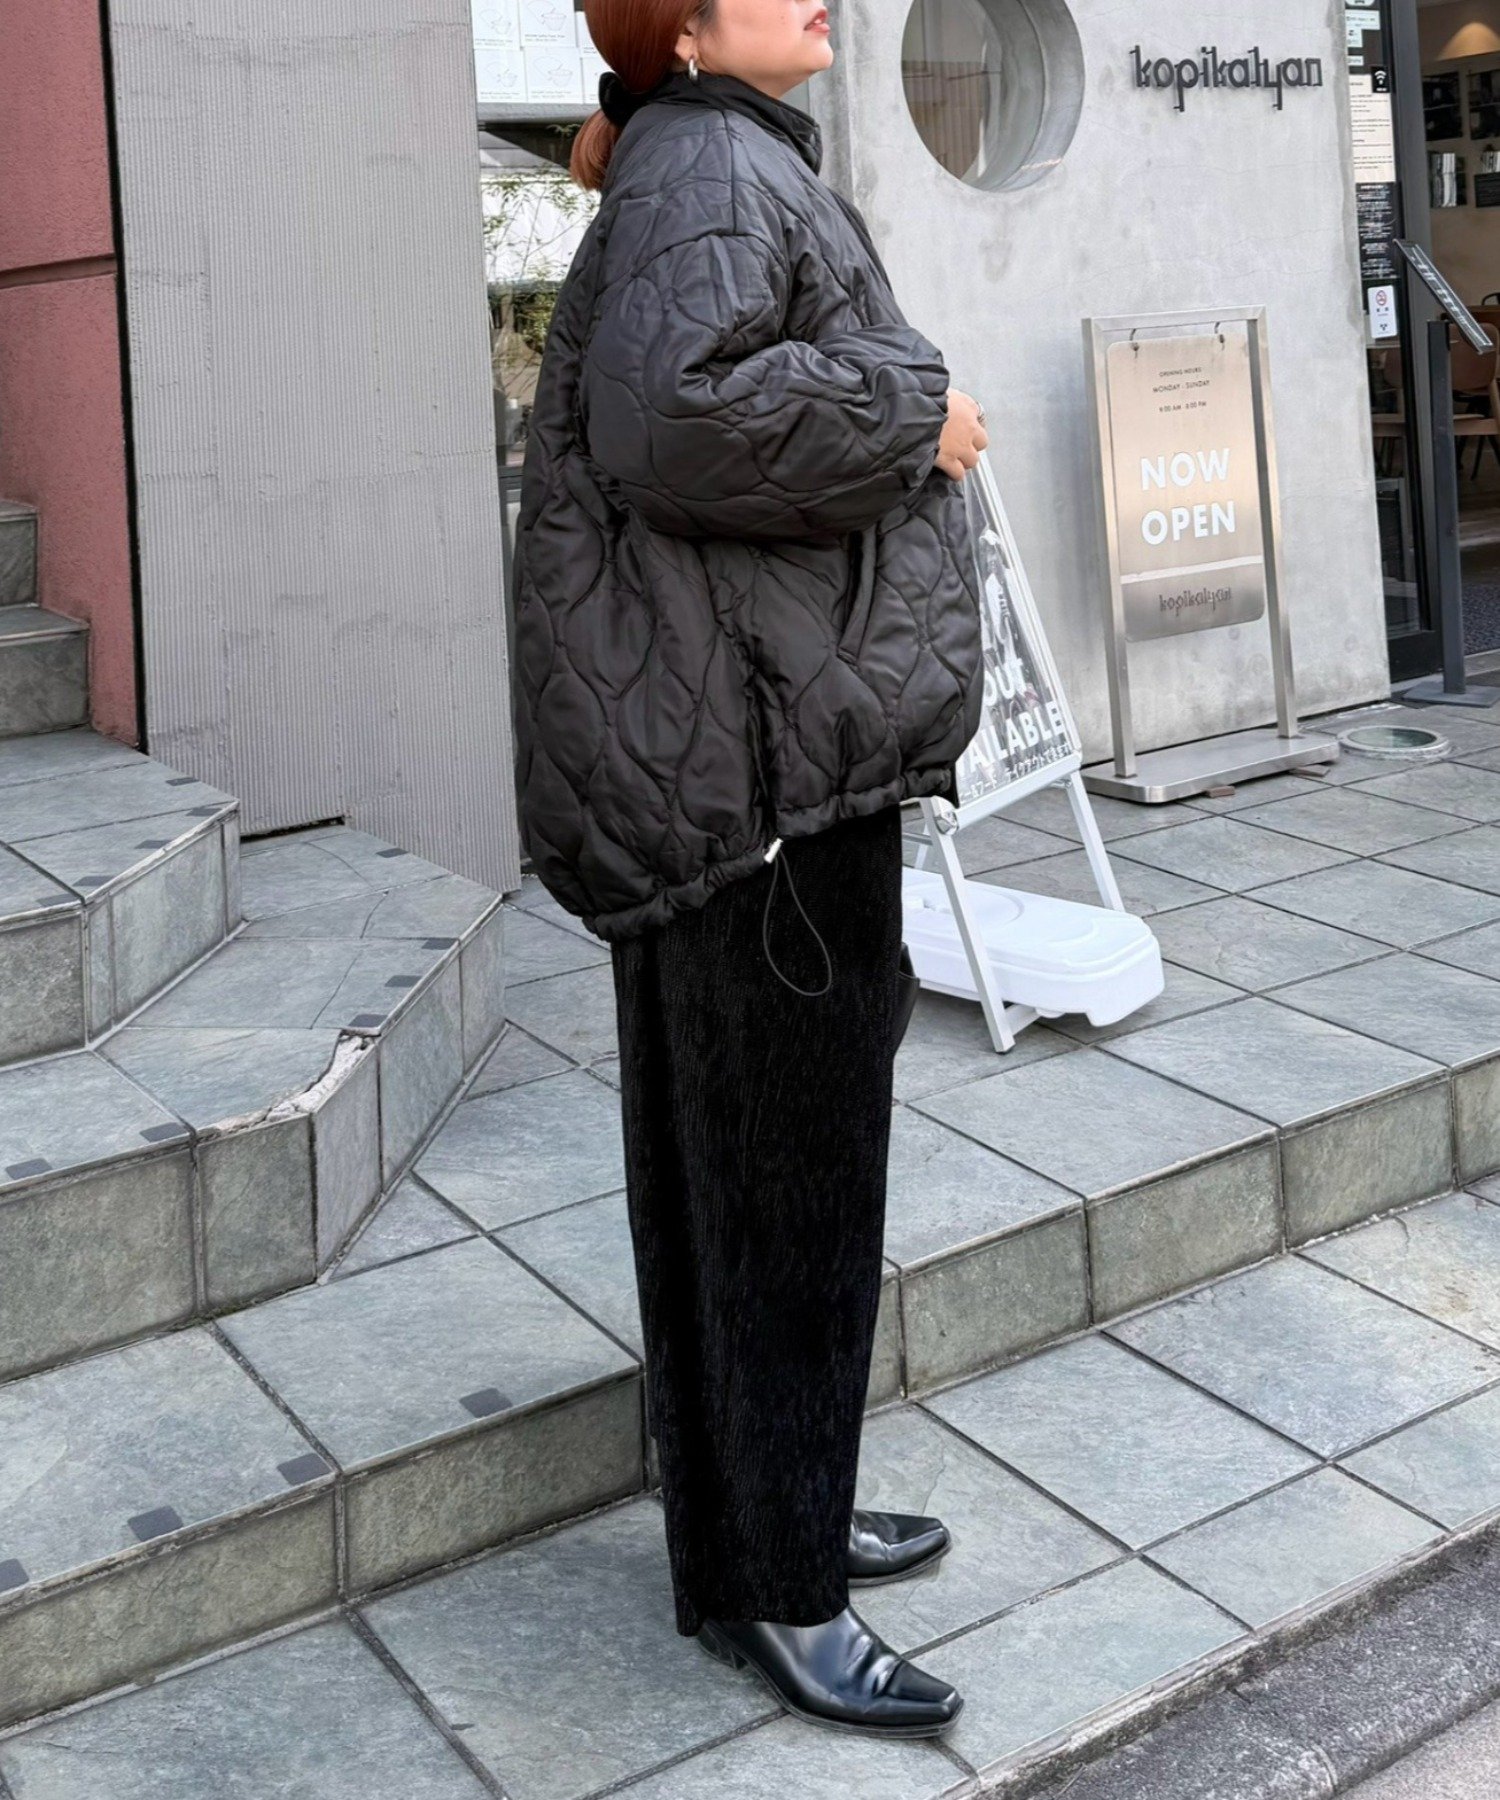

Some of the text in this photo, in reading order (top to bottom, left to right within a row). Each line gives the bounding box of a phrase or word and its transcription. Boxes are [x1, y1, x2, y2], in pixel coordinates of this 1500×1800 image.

[1129, 44, 1323, 112] kopikalyan
[1153, 380, 1210, 392] MONDAY SUNDAY
[1140, 447, 1230, 491] NOW
[1142, 500, 1236, 545] OPEN
[1159, 586, 1233, 617] kopikalyan
